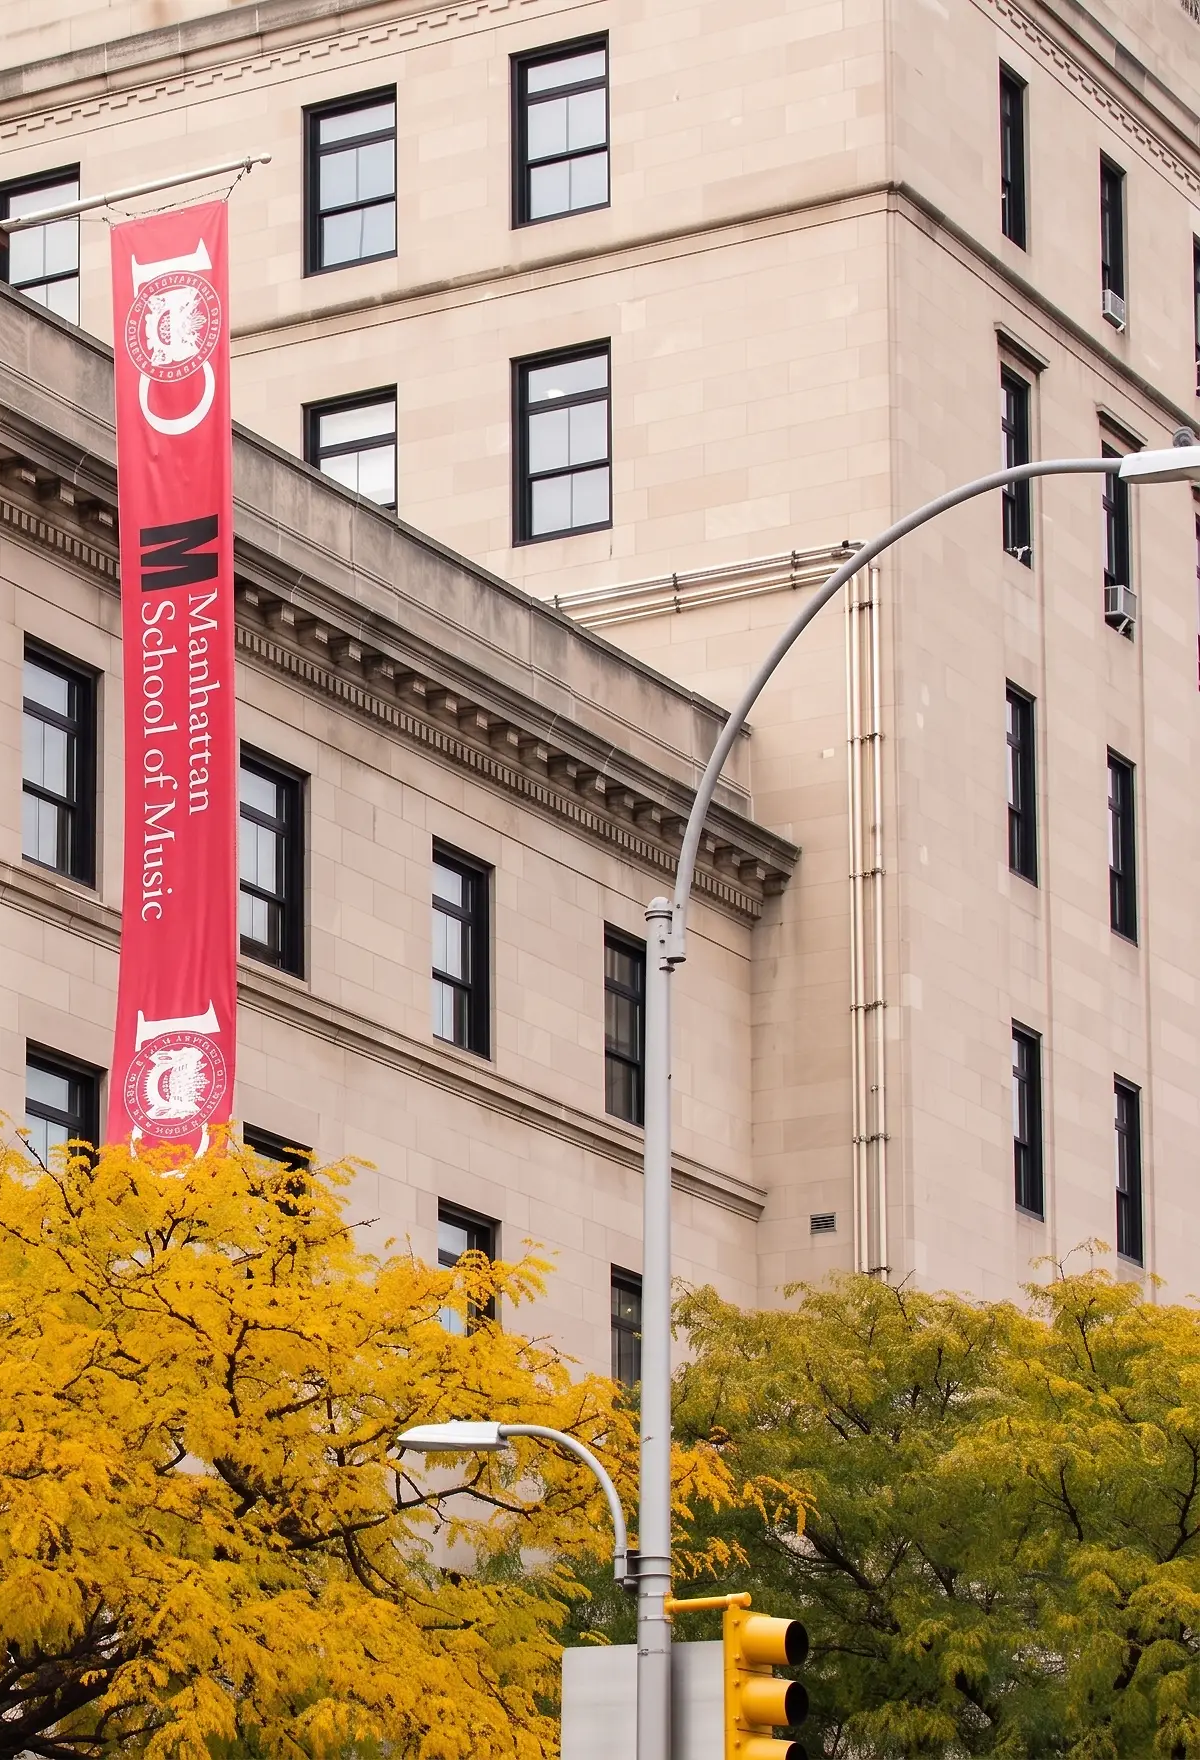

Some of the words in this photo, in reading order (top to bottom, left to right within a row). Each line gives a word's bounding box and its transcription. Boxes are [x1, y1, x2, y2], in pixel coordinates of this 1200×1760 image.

[140, 514, 218, 592] M
[141, 600, 178, 738] School
[188, 587, 220, 815] Manhattan
[143, 748, 178, 790] of
[141, 797, 176, 922] Music
